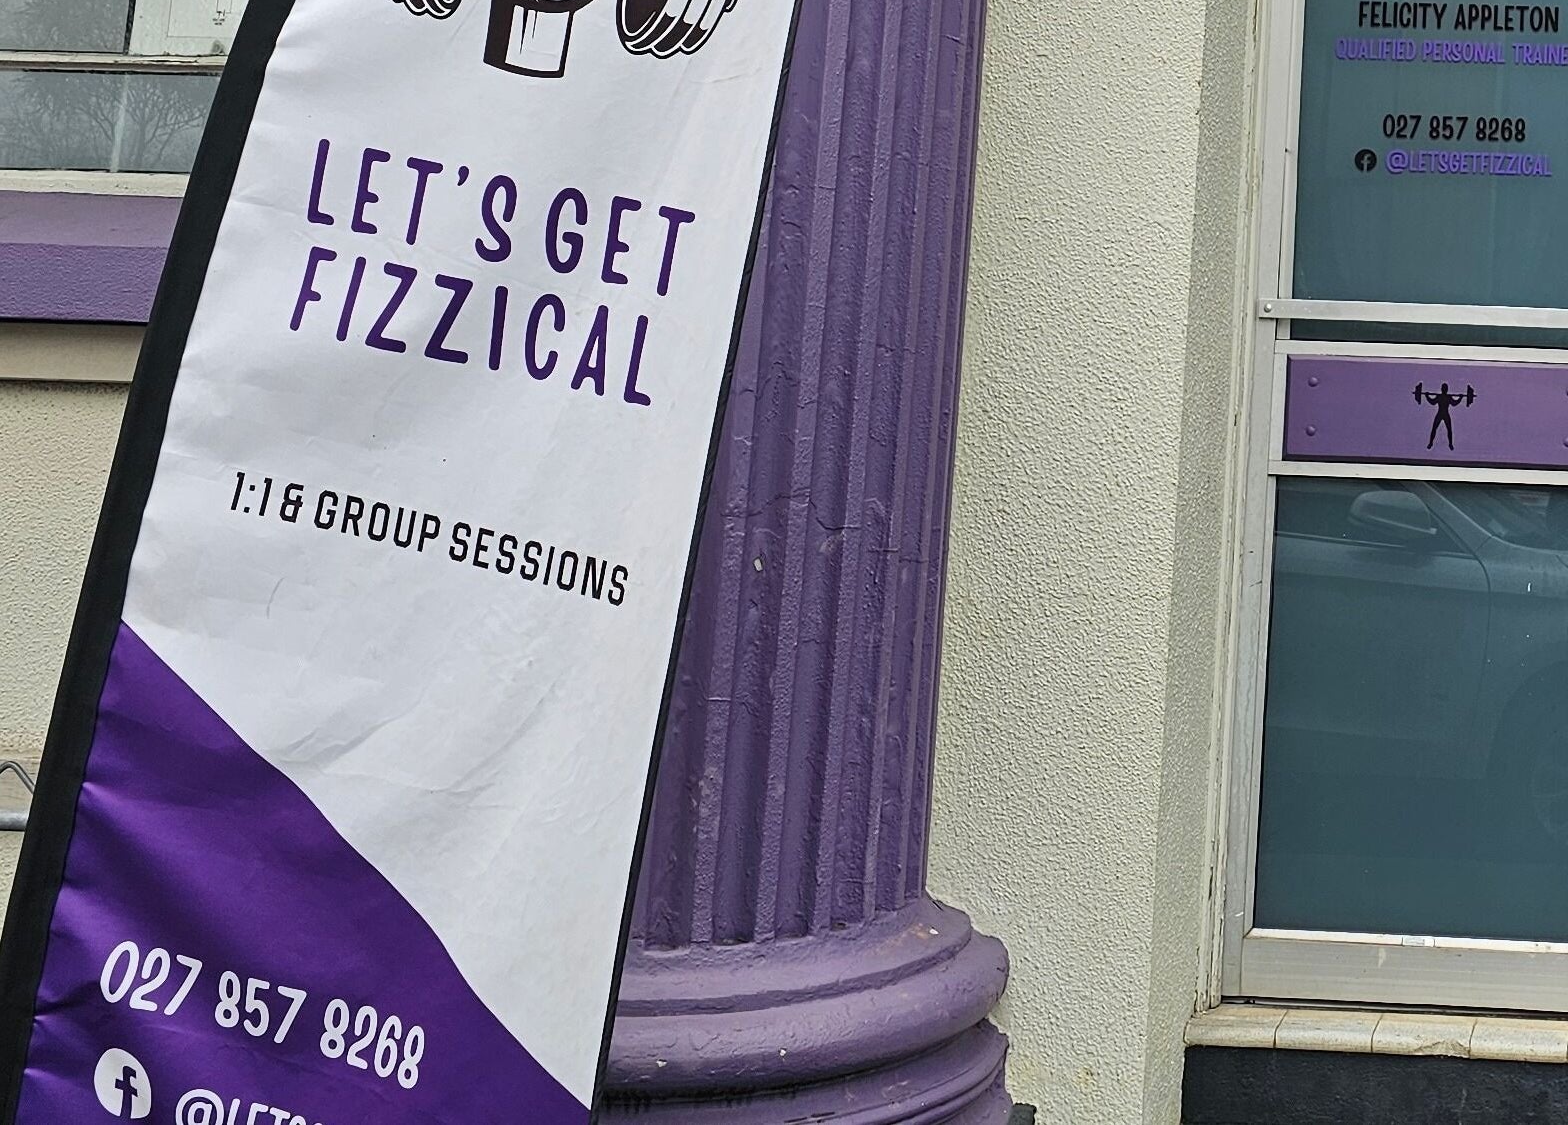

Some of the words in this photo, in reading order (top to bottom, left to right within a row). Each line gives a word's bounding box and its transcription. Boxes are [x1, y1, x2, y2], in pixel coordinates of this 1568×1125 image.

[1335, 38, 1417, 61] QUALIFIED
[1422, 39, 1505, 64] PERSONAL
[1359, 1, 1447, 29] FELICITY
[1454, 4, 1559, 32] APPLETON
[1383, 114, 1422, 139] 027
[1429, 115, 1468, 141] 857
[1476, 117, 1526, 142] 8268
[1386, 149, 1553, 177] @LETSGETFIZZICAL
[307, 139, 518, 263] LET'S
[545, 187, 696, 297] GET
[289, 245, 652, 407] FIZZICAL
[230, 471, 272, 517] 1:1
[280, 482, 304, 524] &
[313, 489, 441, 553] GROUP
[448, 521, 629, 608] SESSIONS
[100, 940, 203, 1016] 027
[214, 970, 307, 1044] 857
[318, 999, 425, 1090] 8268
